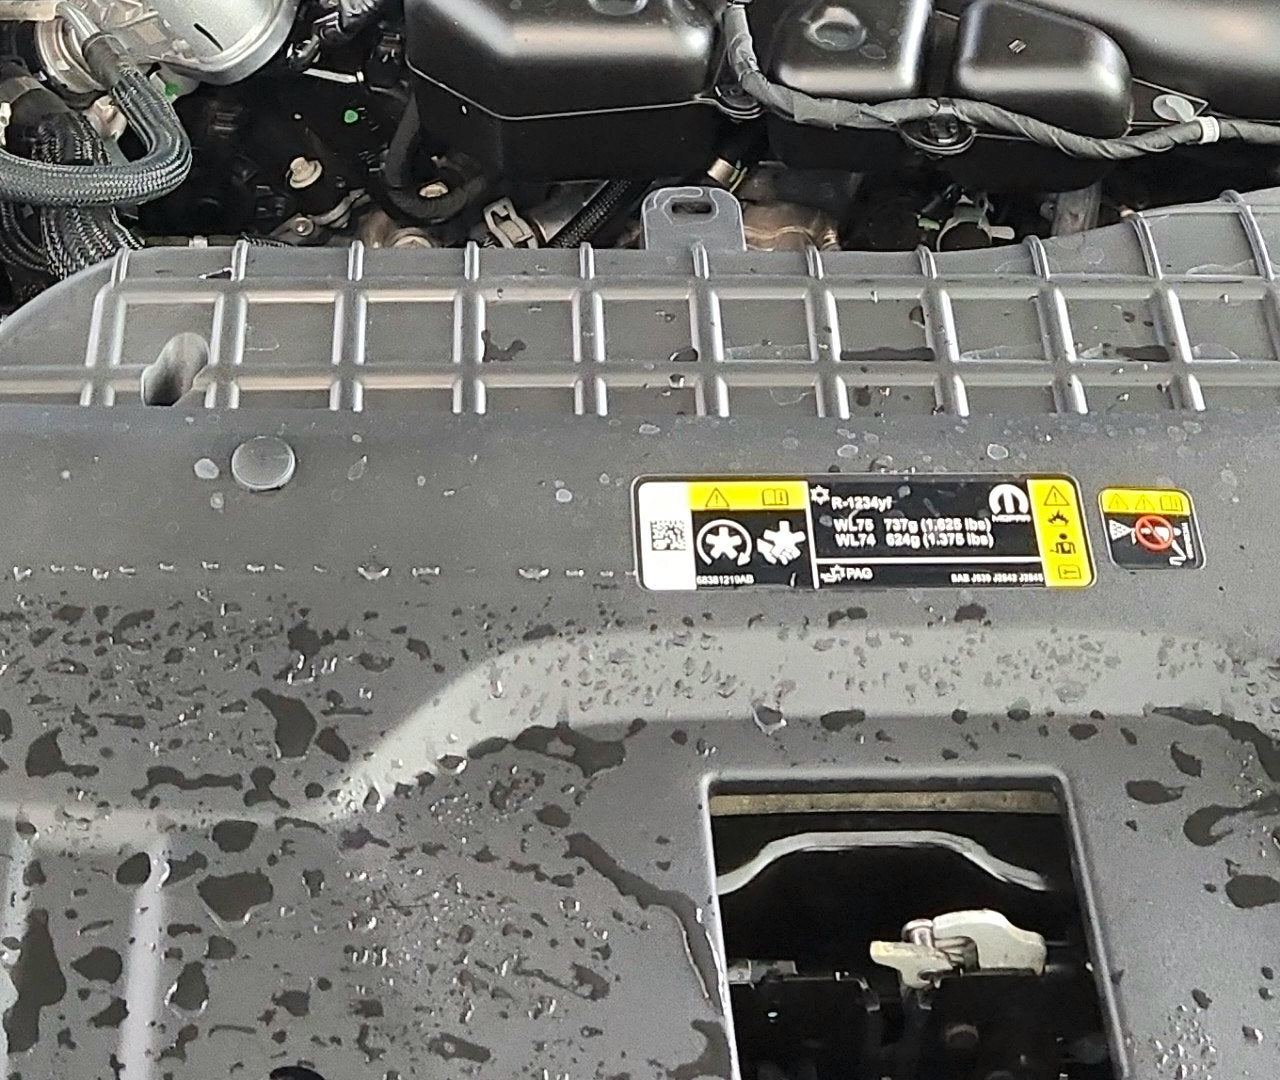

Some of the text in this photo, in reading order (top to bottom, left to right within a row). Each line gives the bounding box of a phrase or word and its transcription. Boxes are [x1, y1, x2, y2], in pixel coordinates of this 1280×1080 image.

[831, 495, 893, 513] R-1234yf
[833, 517, 875, 533] WL75
[883, 517, 919, 534] 737g
[963, 516, 992, 533] lbs)
[834, 532, 877, 548] WL74
[885, 532, 921, 550] 624g
[966, 532, 995, 549] lbs)
[846, 567, 874, 580] PAG
